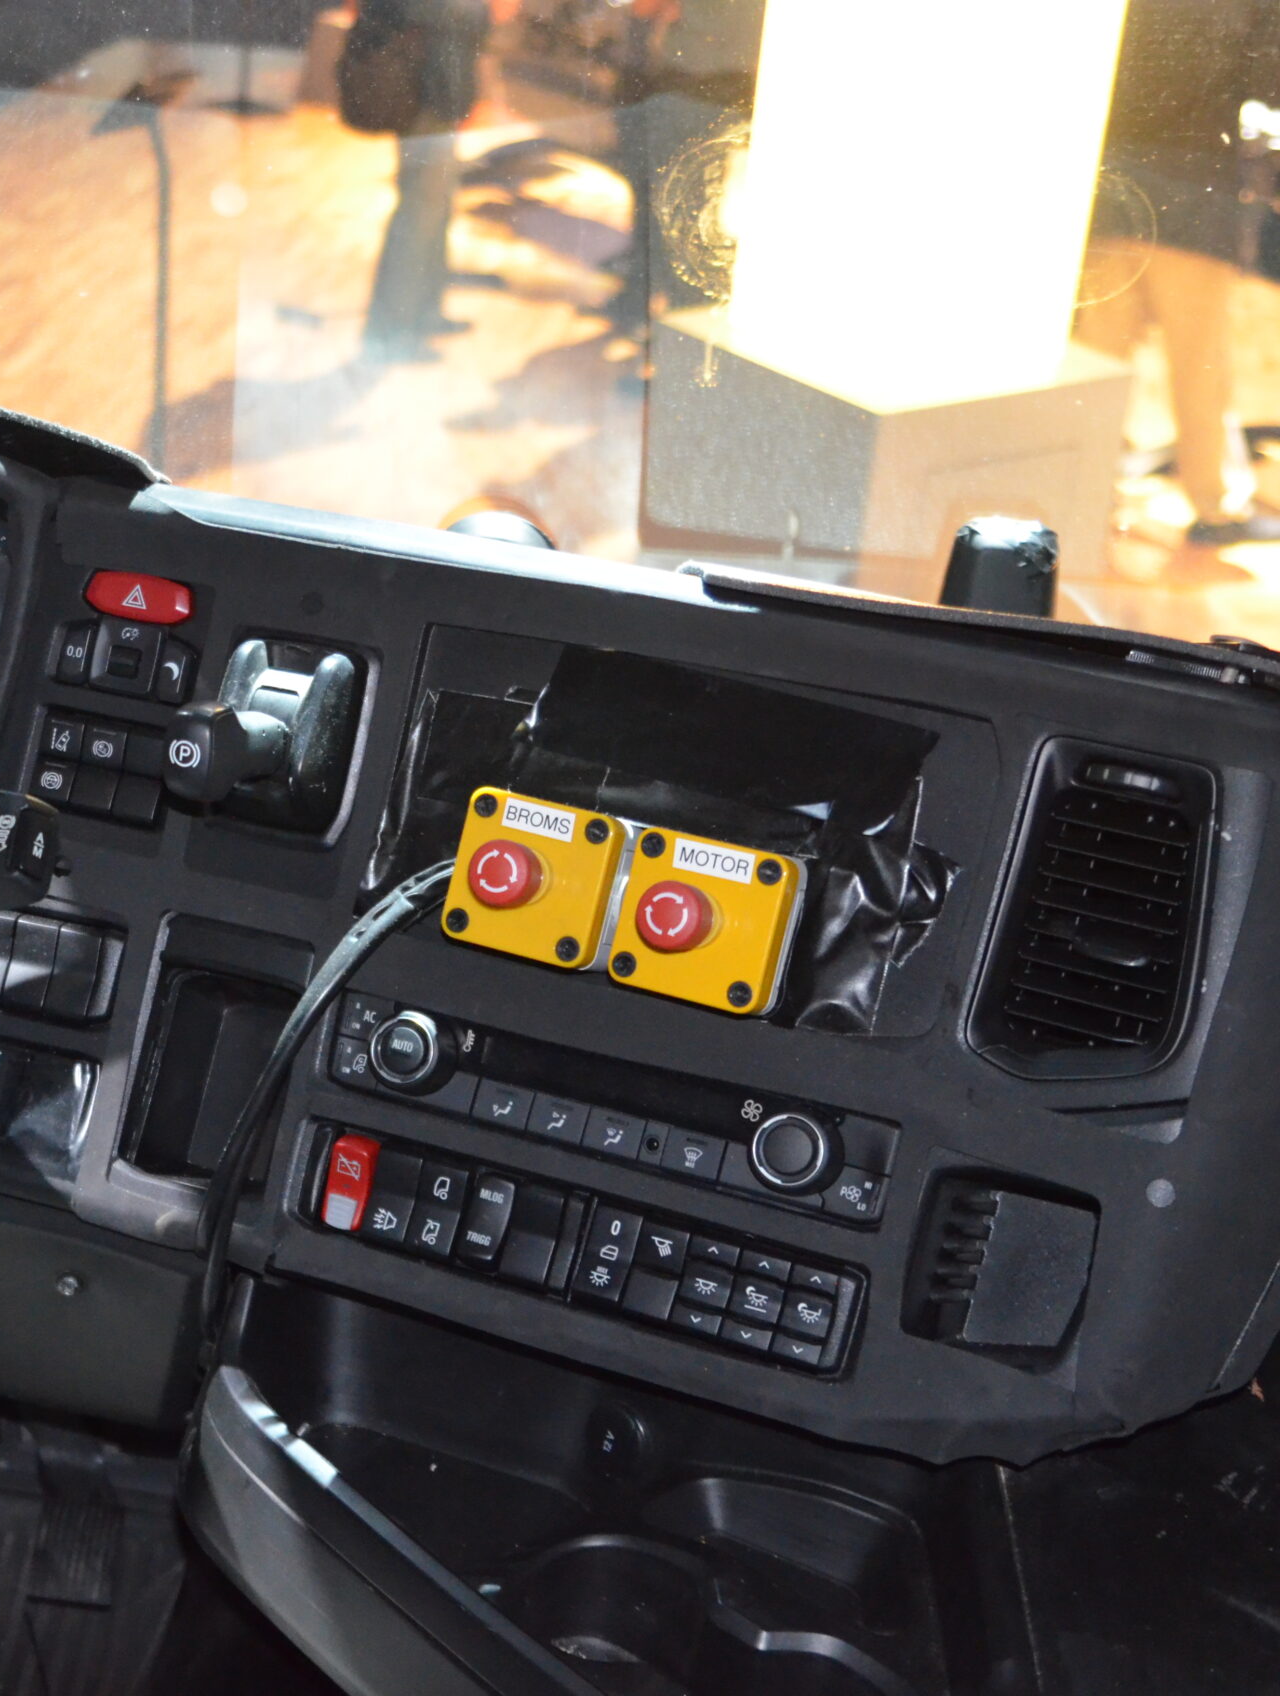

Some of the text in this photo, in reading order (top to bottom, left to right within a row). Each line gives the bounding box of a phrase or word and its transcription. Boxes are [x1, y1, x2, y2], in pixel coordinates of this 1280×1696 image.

[505, 804, 572, 835] BROMS
[678, 846, 750, 877] MOTOR
[363, 1009, 377, 1024] AC
[391, 1038, 414, 1053] AUTO
[479, 1187, 505, 1205] MLOG
[466, 1229, 492, 1247] TRIGG
